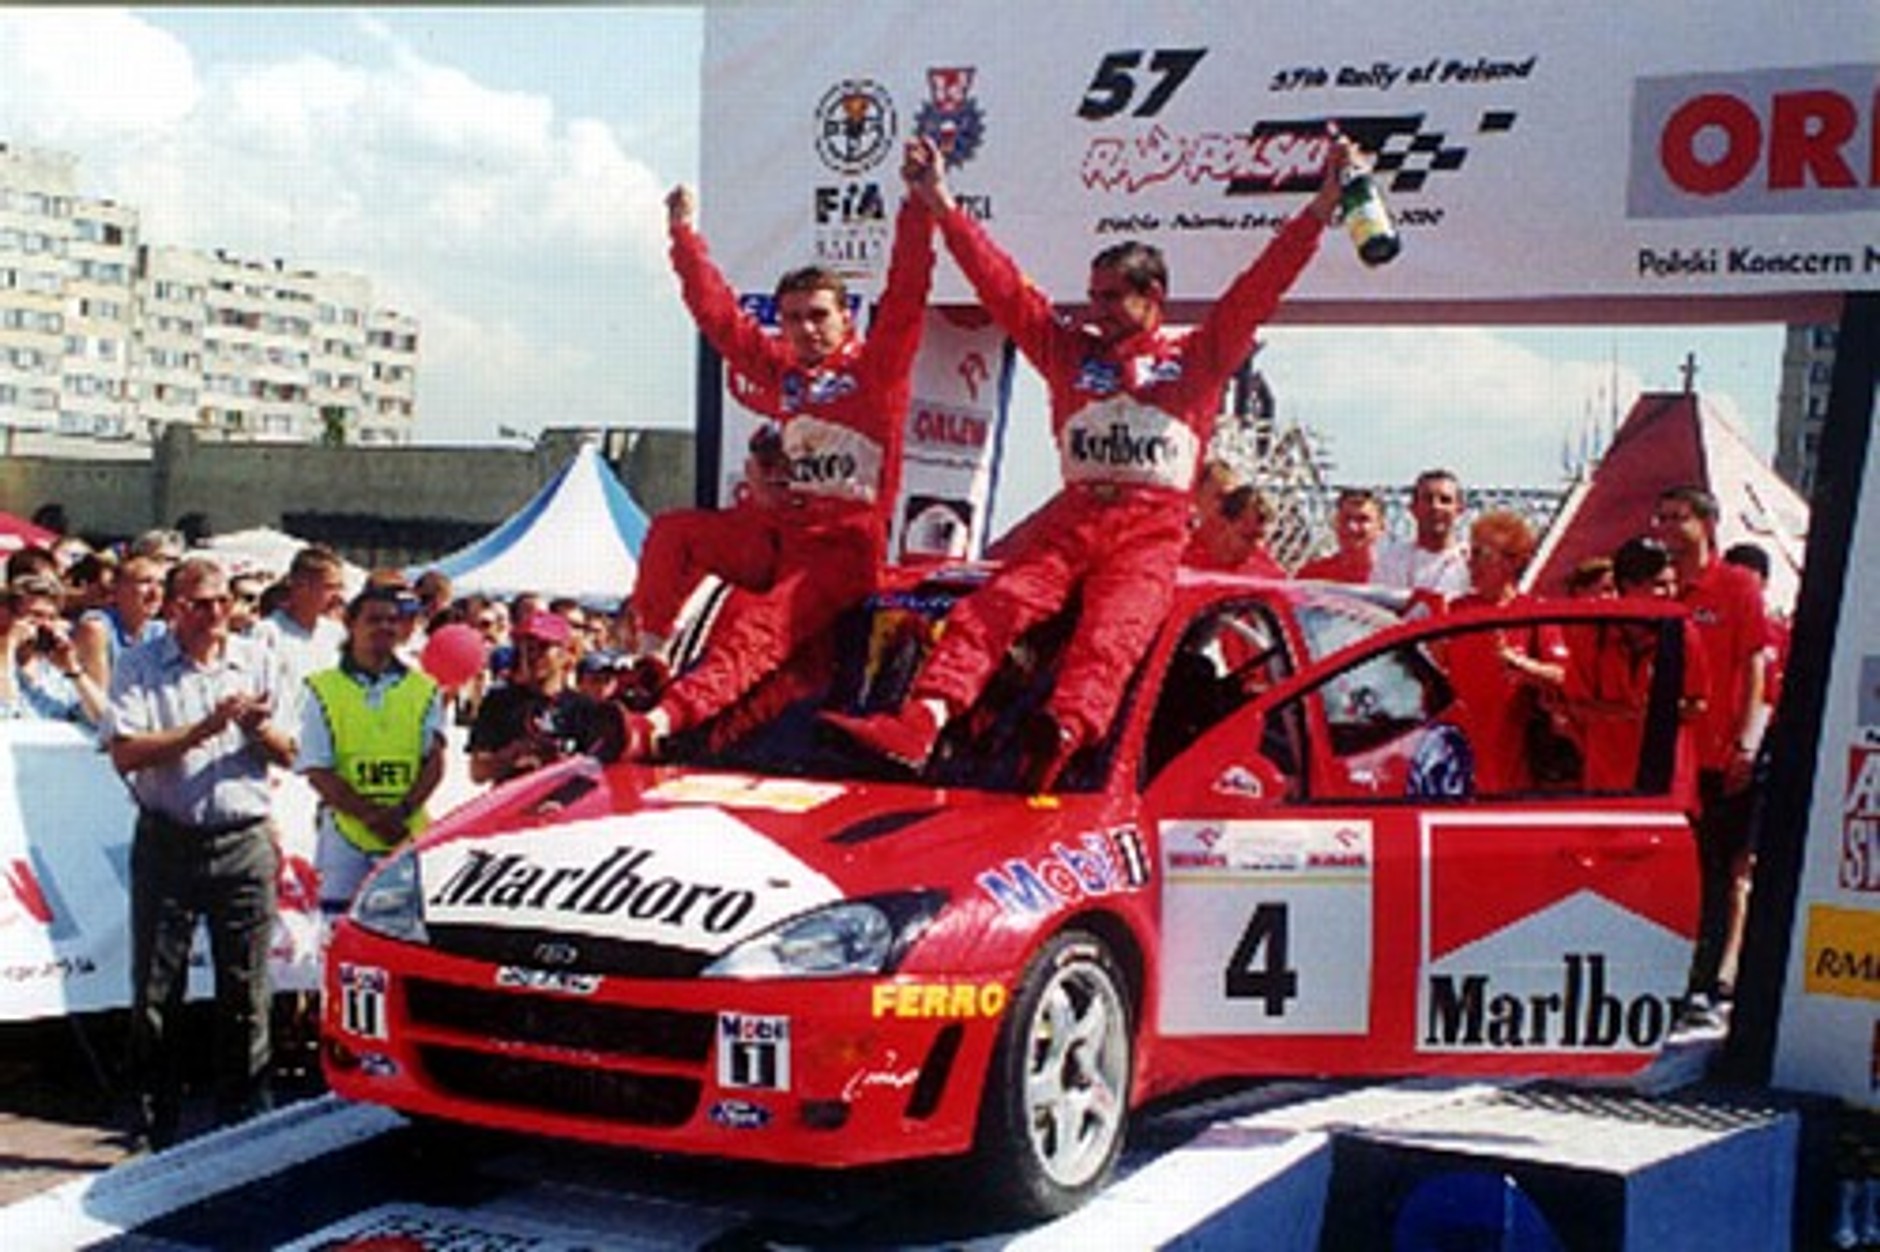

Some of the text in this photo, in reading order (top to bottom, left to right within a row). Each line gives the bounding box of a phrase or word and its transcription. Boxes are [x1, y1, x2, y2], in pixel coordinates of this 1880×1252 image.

[1076, 46, 1209, 120] 57
[1335, 63, 1402, 91] Rally
[1406, 56, 1440, 84] of
[1440, 54, 1538, 85] Poland
[1659, 87, 1880, 196] OR
[1638, 248, 1718, 277] Polski
[1728, 248, 1854, 274] Koncern
[428, 846, 757, 933] Marlboro
[1225, 902, 1298, 1017] 4
[1816, 948, 1880, 983] RM
[872, 983, 1007, 1018] FERRO
[1425, 953, 1692, 1048] Marlbor
